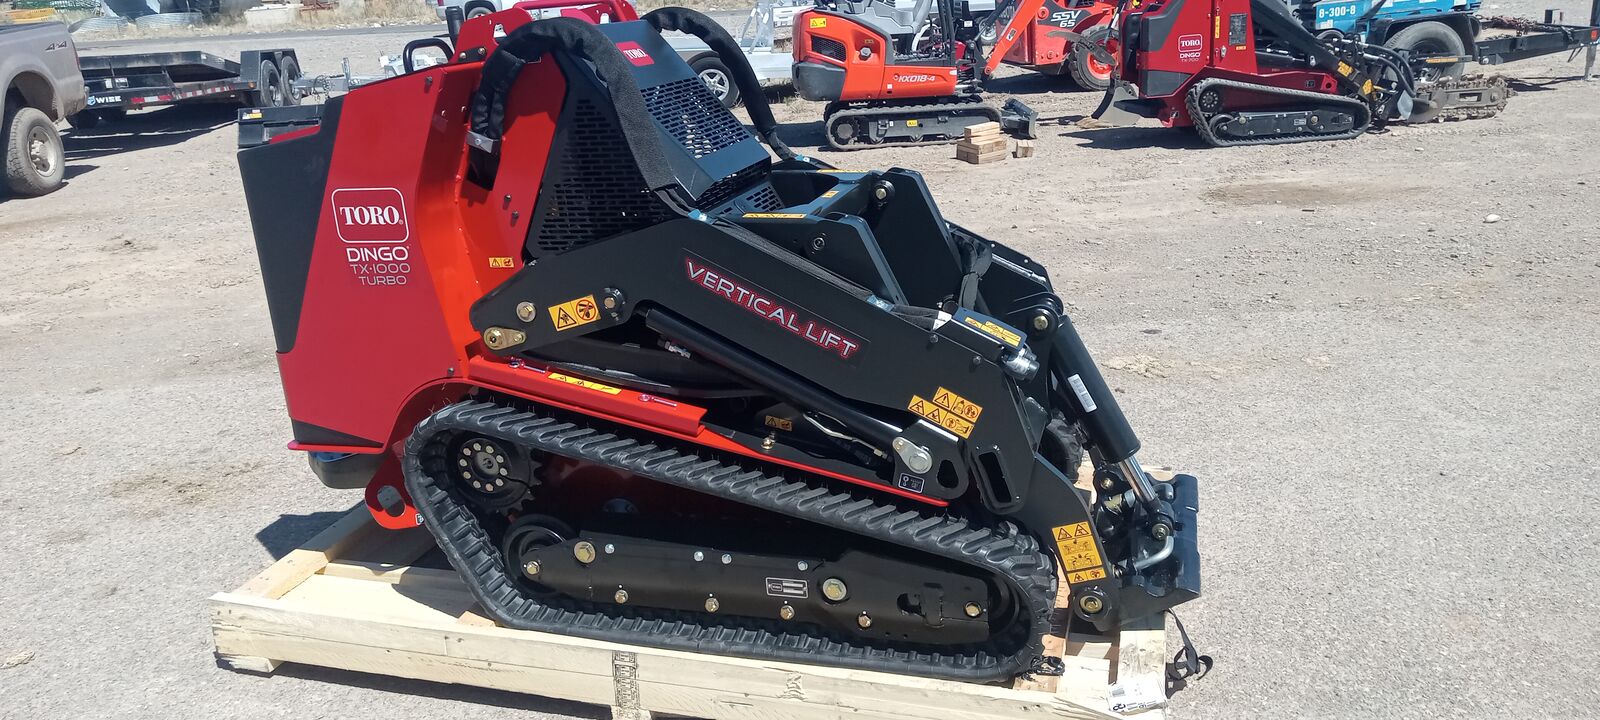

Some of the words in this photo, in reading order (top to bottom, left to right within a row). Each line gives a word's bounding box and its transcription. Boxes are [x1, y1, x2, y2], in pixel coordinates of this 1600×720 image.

[1050, 10, 1082, 22] SSV
[1318, 5, 1356, 18] 8-300-8
[1060, 20, 1076, 28] 65
[1180, 39, 1201, 47] TORO
[622, 48, 647, 59] TORO
[898, 74, 936, 83] KX018-4
[95, 95, 122, 104] WISE
[339, 205, 402, 226] TORO
[345, 246, 409, 262] DINGO
[357, 275, 408, 286] TURBO
[686, 260, 801, 333] VERTICAL
[804, 321, 858, 357] LIFT
